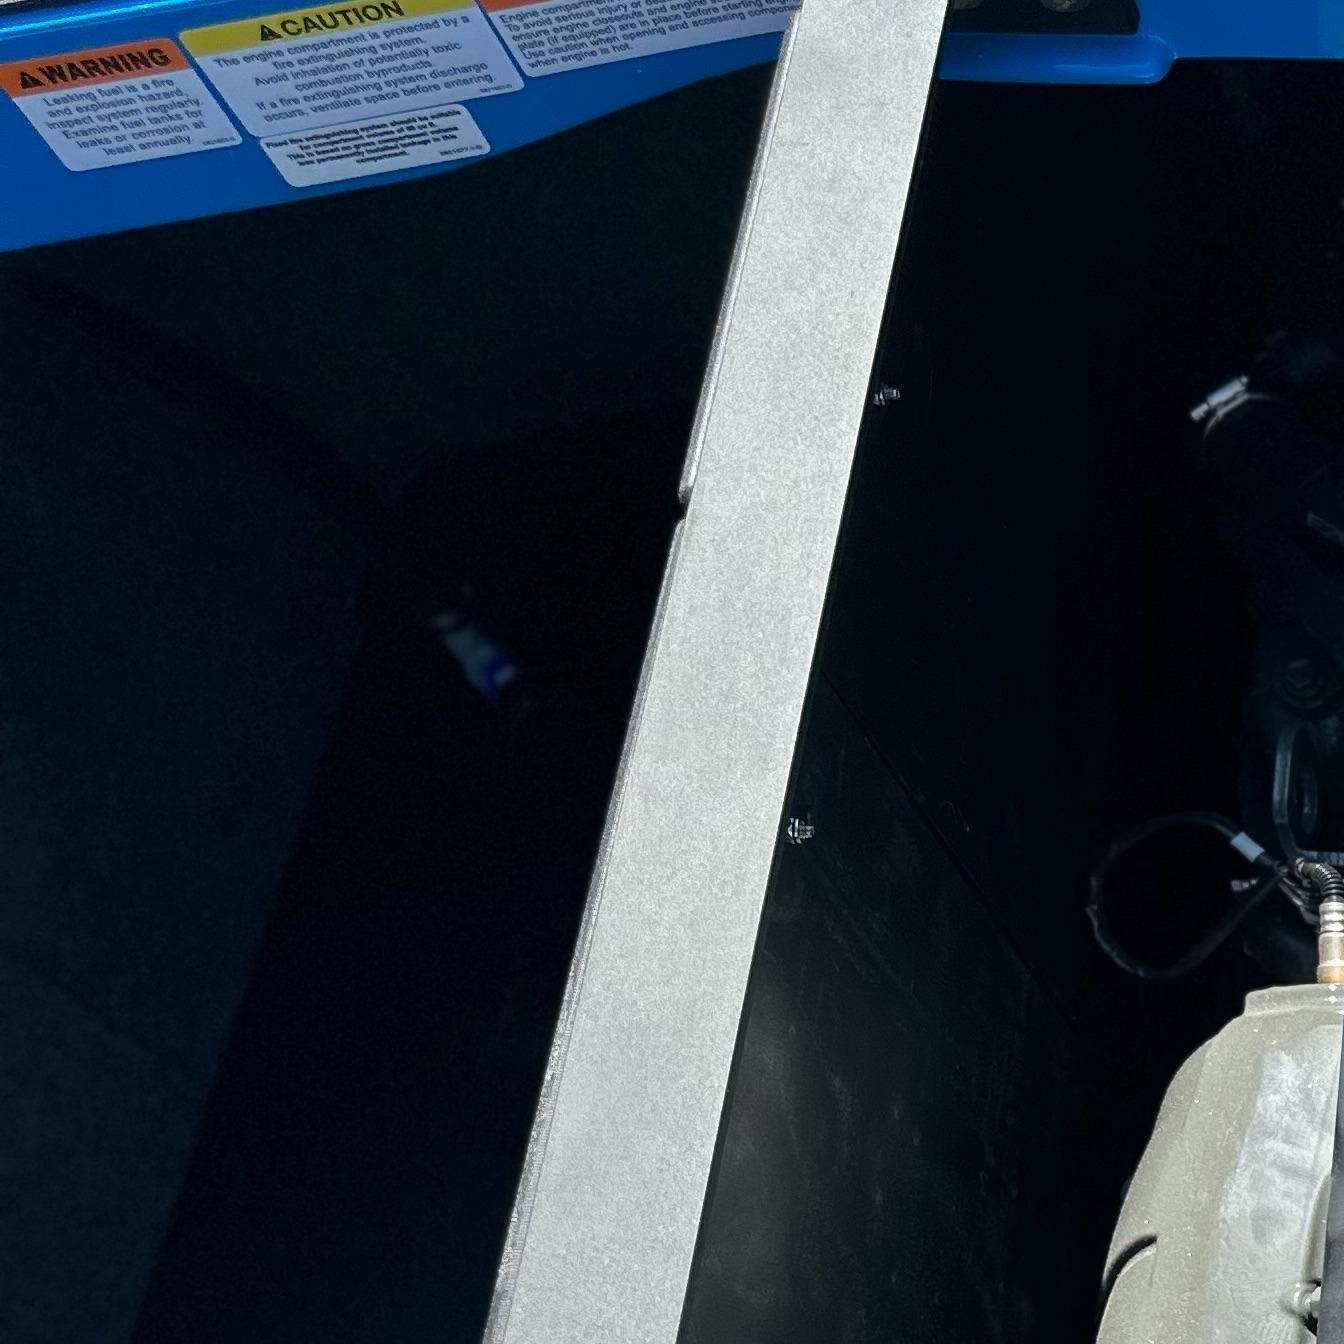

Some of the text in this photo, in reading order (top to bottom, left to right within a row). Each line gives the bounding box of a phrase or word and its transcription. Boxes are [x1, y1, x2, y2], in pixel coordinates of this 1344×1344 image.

[280, 1, 404, 36] CAUTION
[499, 10, 539, 24] Engine
[504, 24, 520, 33] To
[523, 16, 553, 29] avoid
[554, 10, 596, 23] serious
[597, 4, 628, 15] injury
[512, 28, 550, 42] ensure
[552, 20, 590, 34] engine
[592, 10, 644, 25] closeouts
[648, 5, 668, 16] and
[517, 40, 545, 51] plate
[562, 25, 616, 44] equipped)
[619, 22, 636, 31] are
[638, 19, 649, 27] in
[652, 13, 682, 26] place
[684, 6, 720, 18] before
[213, 14, 470, 68] The engine compartment is protected by a
[522, 50, 546, 59] Use
[549, 41, 588, 55] caution
[590, 35, 620, 46] when
[622, 26, 666, 40] opening
[669, 21, 689, 32] and
[692, 10, 746, 28] accessing
[37, 48, 172, 83] WARNING
[255, 42, 462, 86] Avoid inhalation of potentially toxic
[273, 60, 294, 70] fire
[297, 44, 378, 66] extinguishing
[528, 58, 558, 69] when
[562, 50, 597, 63] engine
[600, 47, 610, 55] is
[43, 79, 174, 107] Leaking fuel is a fire
[256, 62, 488, 111] If a fire extinguishing system discharge
[294, 72, 364, 92] combustion
[47, 107, 72, 118] and
[76, 97, 136, 115] explosion
[96, 107, 143, 124] system
[264, 110, 309, 122] occurs,
[310, 97, 361, 113] ventilate
[364, 92, 400, 104] space
[401, 82, 441, 96] before
[62, 109, 203, 140] Examine fuel tanks for
[77, 120, 207, 149] leaks or corrosion at
[102, 144, 136, 157] least
[141, 134, 192, 151] annually
